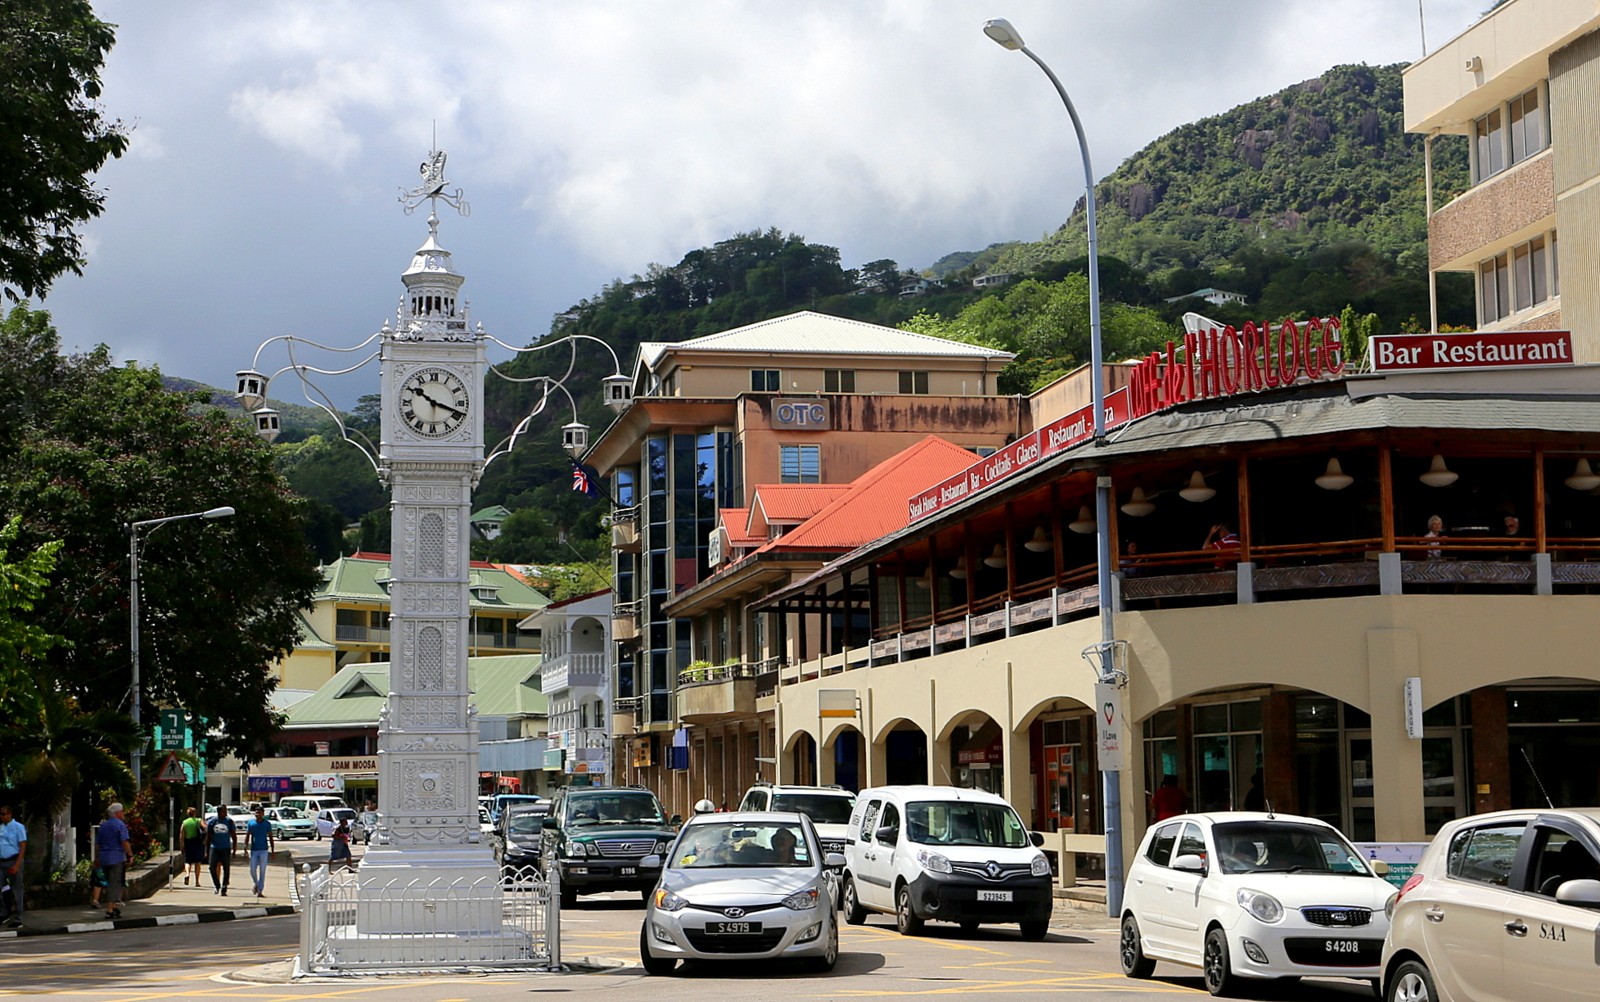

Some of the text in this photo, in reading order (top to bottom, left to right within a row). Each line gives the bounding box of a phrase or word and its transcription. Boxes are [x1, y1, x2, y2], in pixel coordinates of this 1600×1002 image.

[1379, 337, 1568, 365] Bar Restaurant
[777, 403, 826, 425] OTC
[1048, 415, 1087, 449] Restaurant
[970, 443, 1039, 490] Bar Cocktails Glaces
[909, 476, 968, 519] Steak House Restaurant
[331, 760, 376, 770] ADAM MOOSA
[726, 922, 750, 933] 4979
[1539, 922, 1567, 942] SAA
[1325, 940, 1359, 953] S4208
